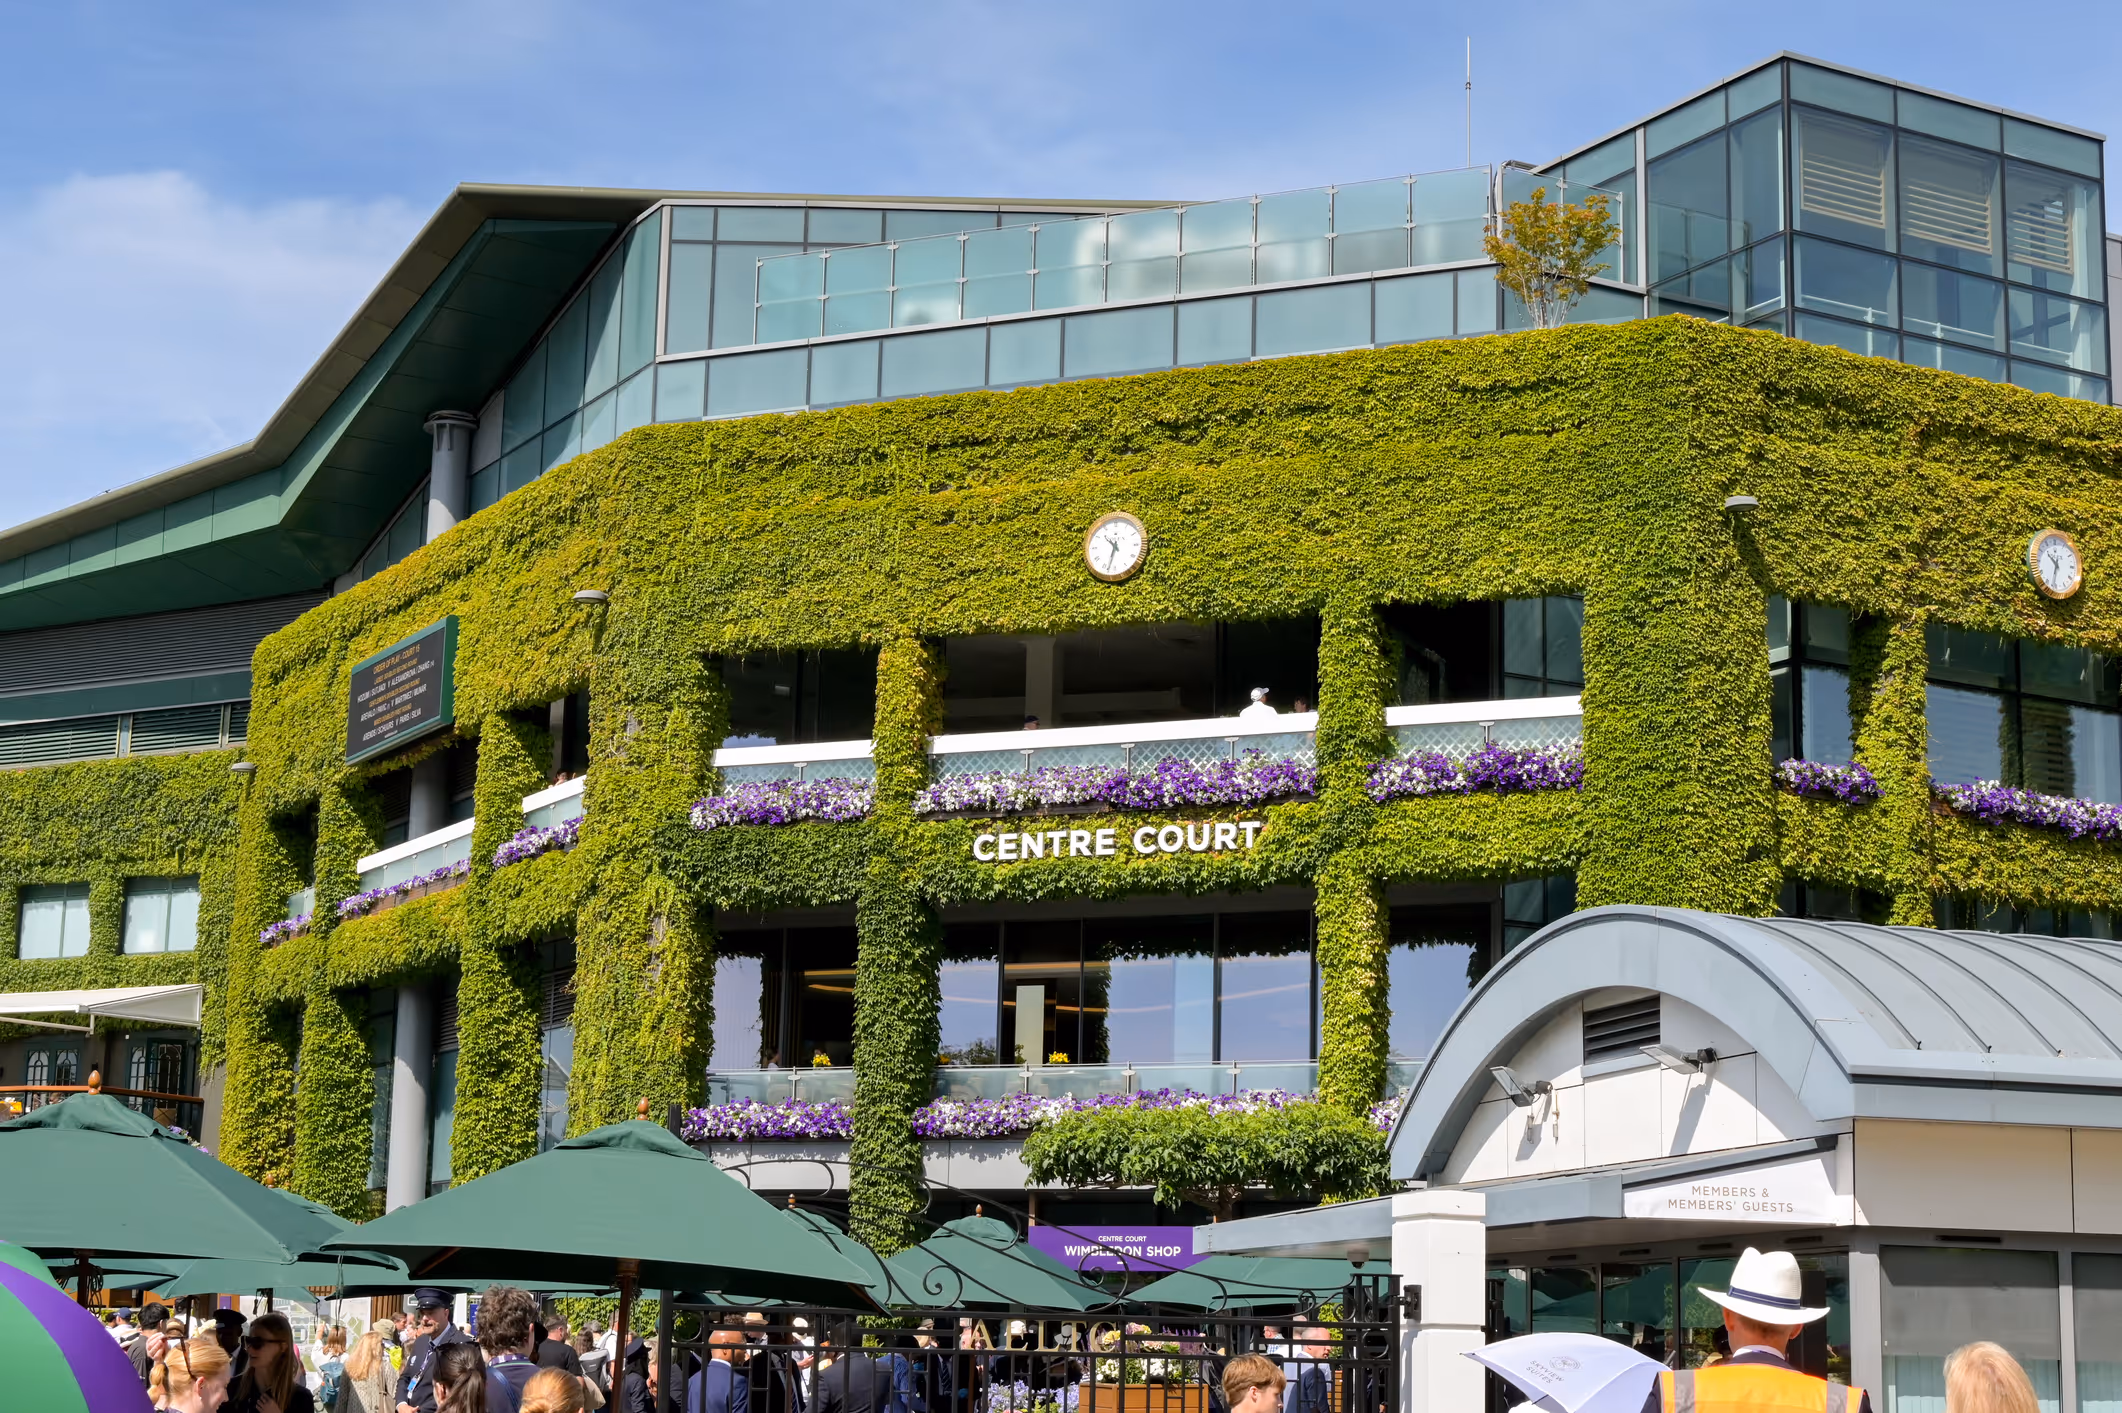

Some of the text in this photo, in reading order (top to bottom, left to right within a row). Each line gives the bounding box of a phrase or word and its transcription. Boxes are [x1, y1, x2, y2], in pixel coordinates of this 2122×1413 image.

[402, 646, 415, 660] COURT
[973, 821, 1261, 861] CENTRE COURT
[1692, 1186, 1769, 1197] MEMBERS &
[1668, 1199, 1794, 1213] MEMBERS' GUESTS
[1146, 1245, 1181, 1257] SHOP
[967, 1319, 1117, 1353] AELTC
[1526, 1366, 1552, 1384] SUITES
[1530, 1360, 1564, 1381] SKYVIEW
